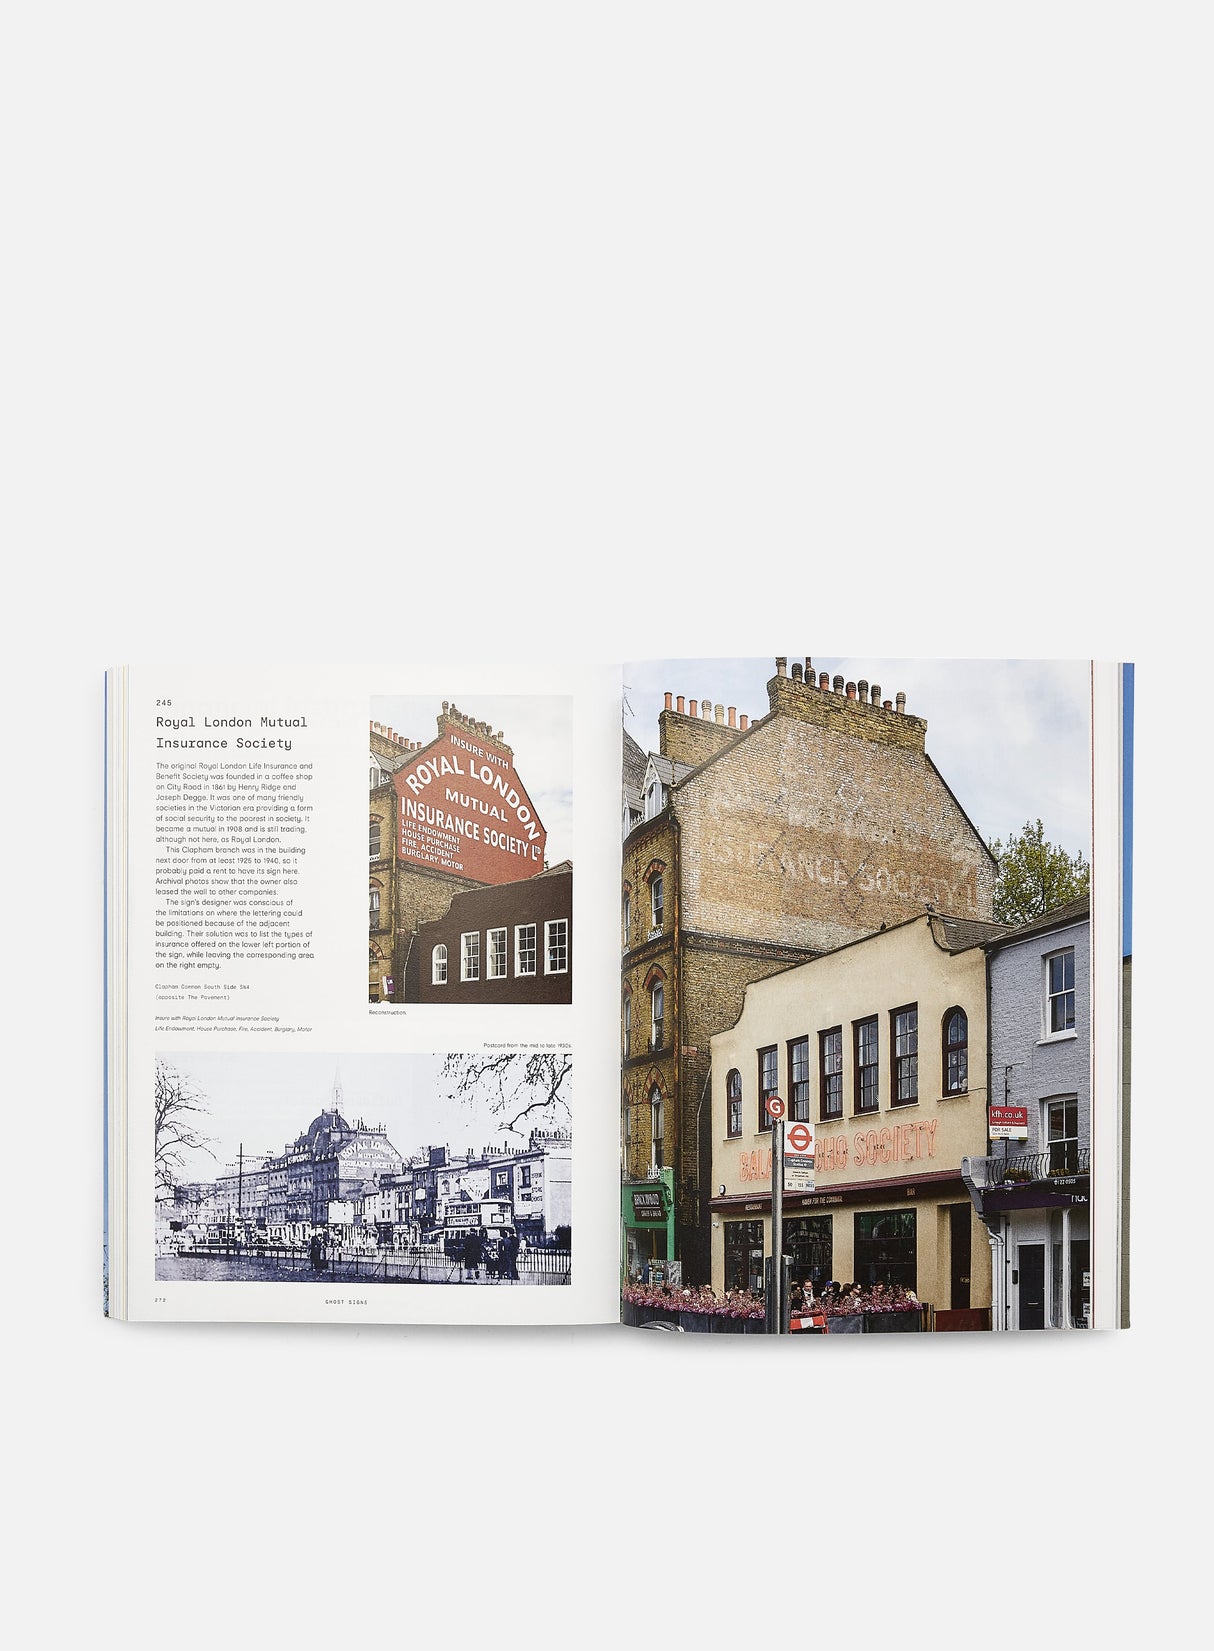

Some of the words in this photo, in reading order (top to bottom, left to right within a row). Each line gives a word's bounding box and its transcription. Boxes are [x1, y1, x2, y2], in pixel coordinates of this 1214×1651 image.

[156, 716, 196, 730] Royal
[204, 716, 252, 728] London
[260, 716, 308, 728] Mutual
[156, 737, 228, 749] Insurance
[236, 737, 292, 751] Society
[450, 734, 484, 758] INSURE
[486, 751, 509, 770] WITH
[170, 763, 197, 771] original
[198, 762, 219, 771] Royal
[155, 772, 181, 780] Benefit
[182, 772, 209, 781] Society
[295, 773, 313, 781] shop
[166, 783, 182, 792] City
[226, 784, 237, 792] by
[238, 784, 260, 792] Henry
[260, 783, 281, 792] Ridge
[182, 794, 209, 802] Degge.
[277, 794, 304, 802] friendly
[405, 755, 465, 796] ROYAL
[469, 759, 541, 841] LONDON
[255, 805, 289, 813] providing
[445, 787, 509, 823] MUTUAL
[401, 796, 480, 841] INSURANCE
[483, 827, 529, 858] SOCIETY
[401, 819, 417, 830] LIFE
[418, 824, 461, 844] ENDOWMENT
[155, 836, 187, 844] although
[231, 836, 252, 844] Royal
[401, 828, 425, 842] HOUSE
[426, 837, 461, 854] PURCHASE
[181, 846, 214, 854] Clapham
[278, 847, 306, 855] building
[420, 845, 454, 860] ACCIDENT
[440, 858, 464, 871] MOTOR
[165, 898, 179, 906] The
[201, 899, 232, 907] designer
[258, 920, 290, 928] adjacent
[769, 1099, 781, 1114] G
[991, 1110, 1024, 1119] kfh.co.uk
[853, 1119, 938, 1167] SOCIETY
[906, 1188, 916, 1196] BAR
